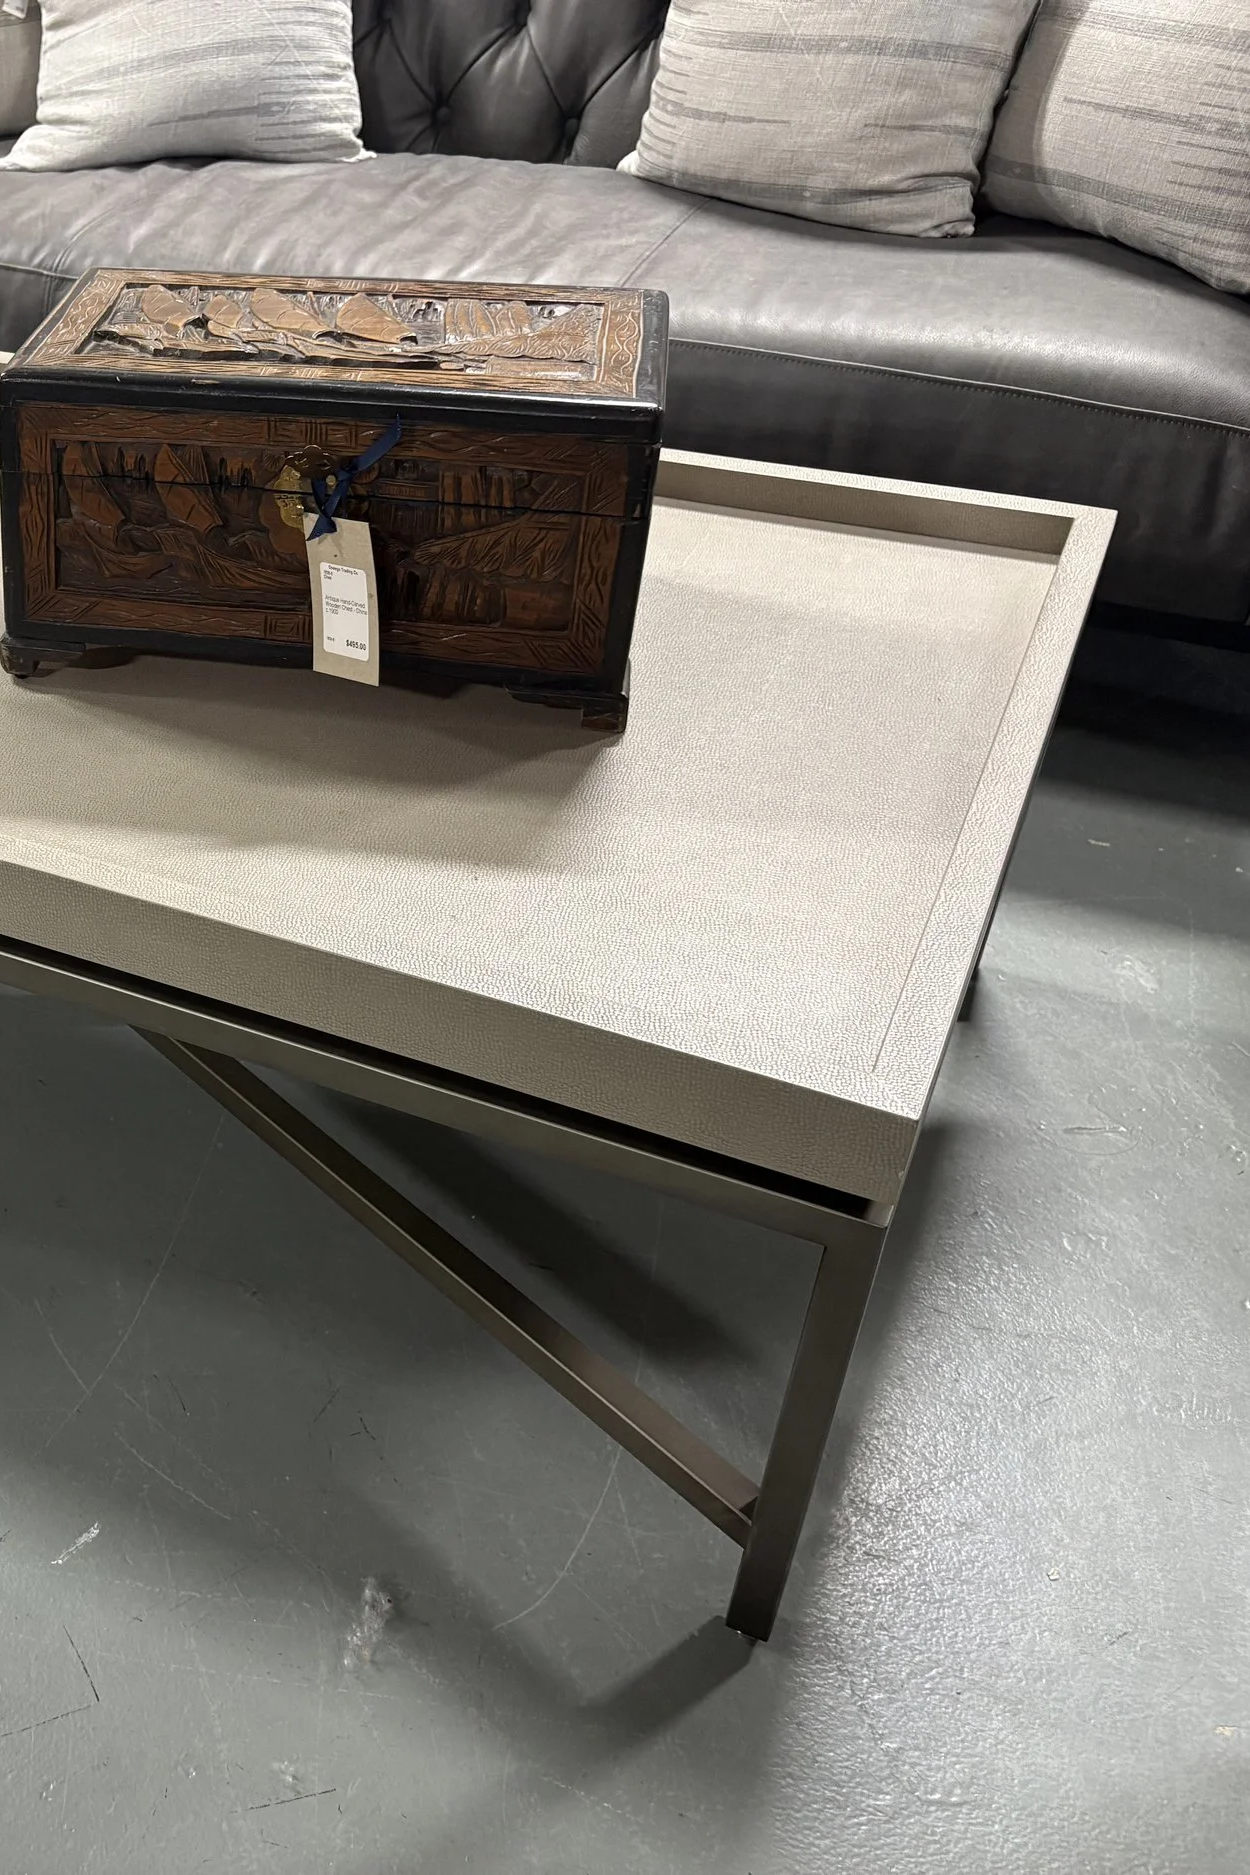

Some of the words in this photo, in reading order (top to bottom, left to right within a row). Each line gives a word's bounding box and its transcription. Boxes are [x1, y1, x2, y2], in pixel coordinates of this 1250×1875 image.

[341, 567, 353, 575] Trading
[324, 594, 340, 603] Antique
[340, 598, 366, 609] Hand-Carved
[325, 601, 341, 609] Wooden
[341, 604, 353, 612] Chest
[355, 607, 368, 616] China
[345, 639, 367, 651] $495.00
